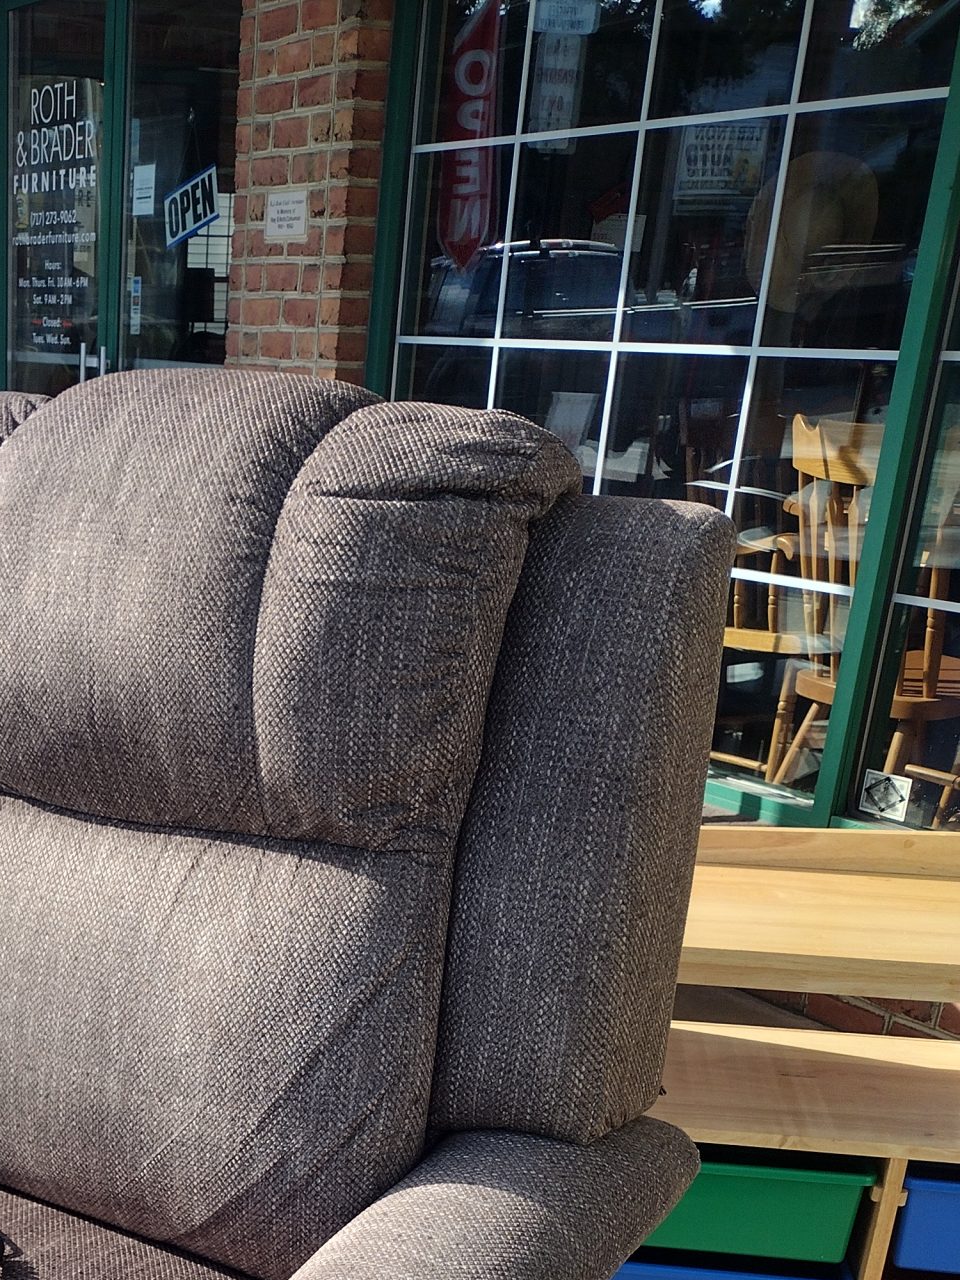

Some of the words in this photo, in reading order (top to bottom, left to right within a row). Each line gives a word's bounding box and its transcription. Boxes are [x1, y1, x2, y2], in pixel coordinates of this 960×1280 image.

[31, 80, 76, 125] ROTH
[16, 131, 28, 168] &
[31, 120, 94, 165] BRADER
[13, 165, 97, 195] FURNITURE
[30, 210, 44, 227] (717)
[45, 209, 77, 225] 273-9062
[168, 172, 215, 239] OPEN
